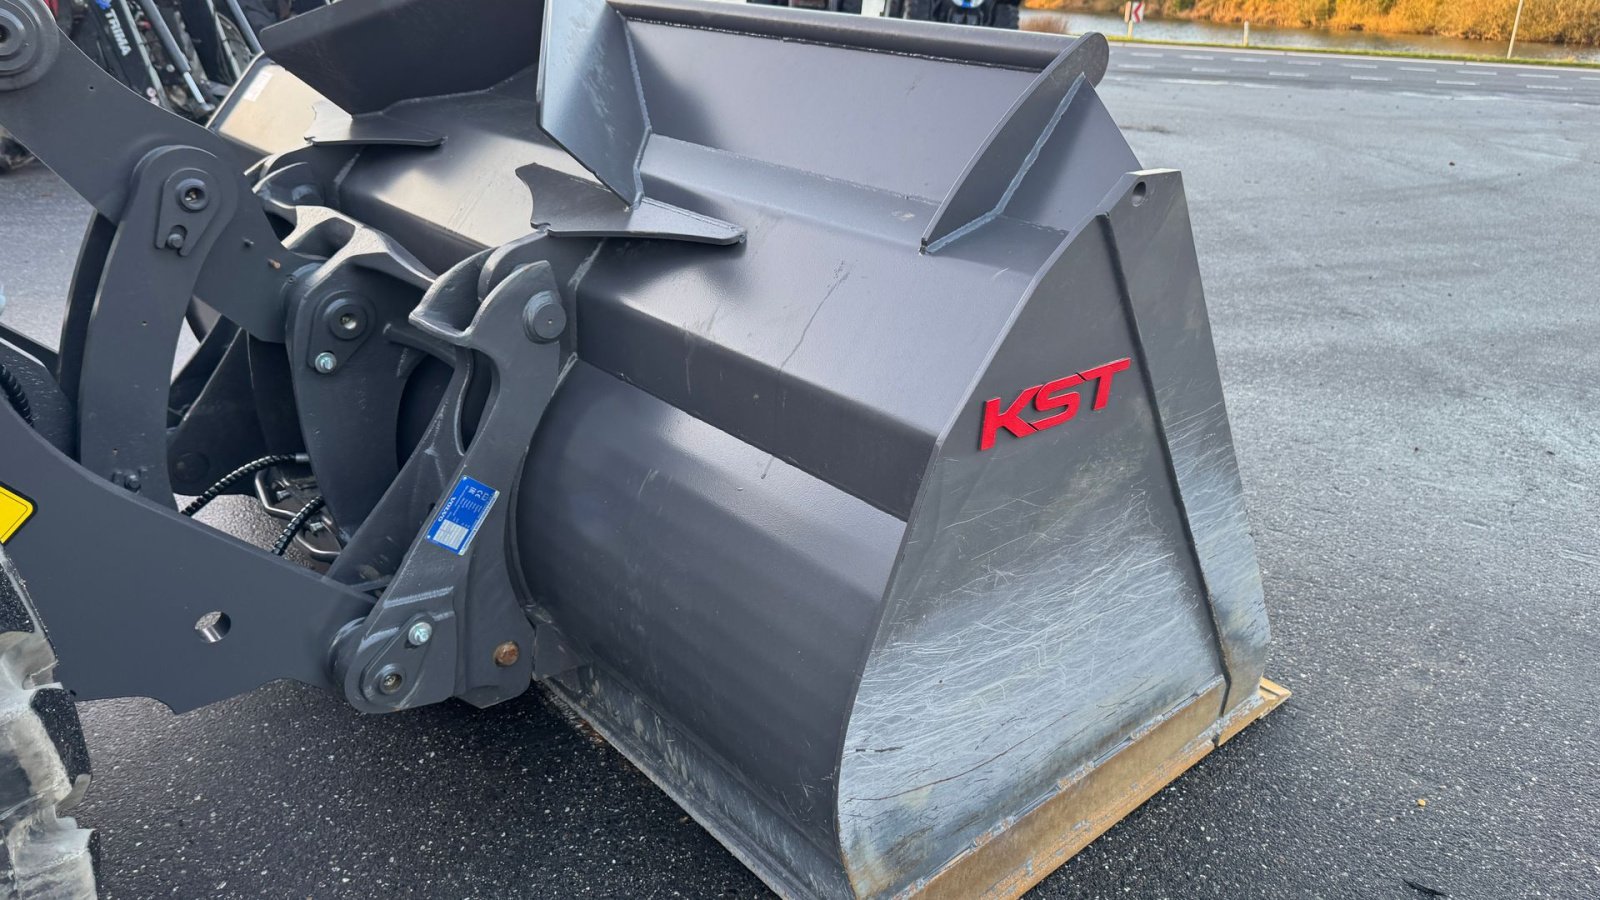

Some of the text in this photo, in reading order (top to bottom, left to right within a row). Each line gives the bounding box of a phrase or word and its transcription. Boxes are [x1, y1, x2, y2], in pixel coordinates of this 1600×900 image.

[105, 8, 131, 56] TRIMA
[979, 357, 1132, 451] KST
[438, 496, 456, 522] VOLVO
